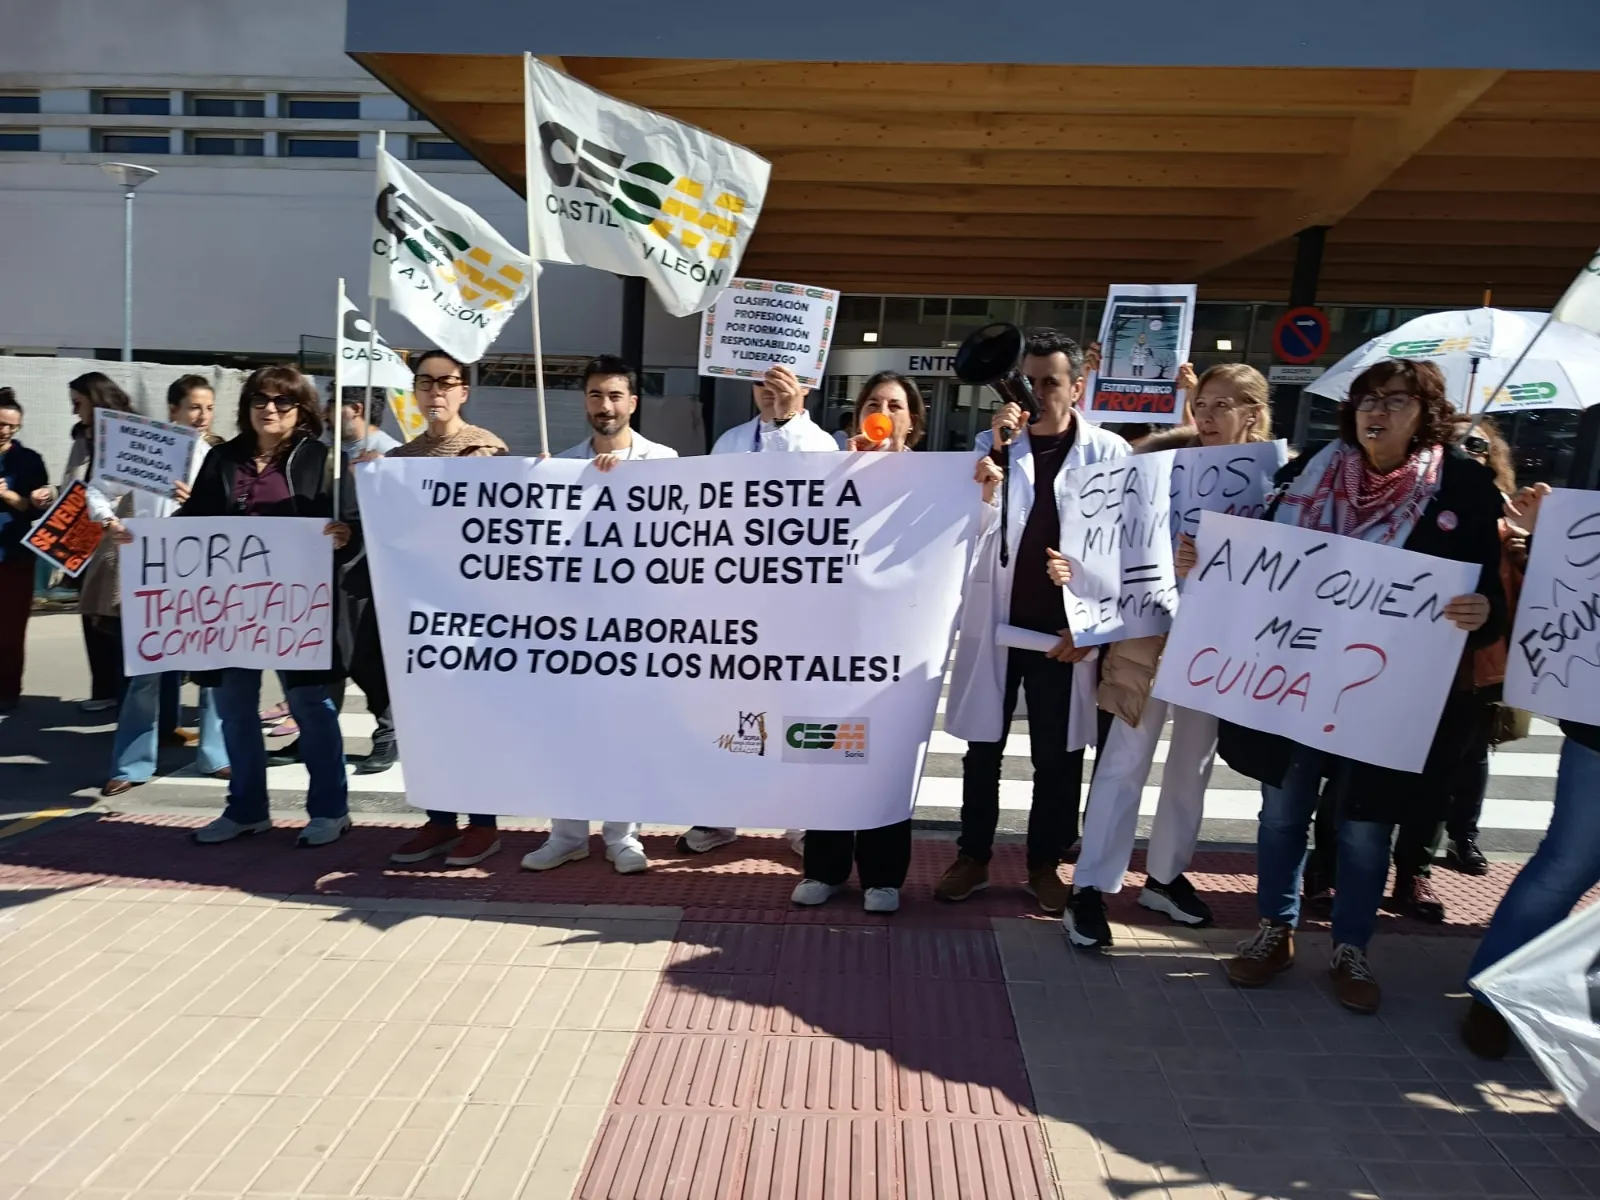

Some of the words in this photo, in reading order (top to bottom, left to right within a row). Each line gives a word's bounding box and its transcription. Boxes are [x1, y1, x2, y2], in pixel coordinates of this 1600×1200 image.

[545, 194, 622, 229] CASTIL
[660, 249, 725, 287] LEÓN
[733, 295, 809, 311] CLASIFICACIÓN
[734, 309, 804, 324] PROFESIONAL
[725, 322, 745, 332] POR
[748, 326, 810, 339] FORMACIÓN
[342, 347, 398, 362] CAST
[720, 335, 811, 354] RESPONSABILIDAD
[732, 350, 739, 358] Y
[740, 350, 797, 365] LIDERAZGO
[909, 355, 958, 371] ENTR
[1093, 391, 1175, 412] PROPIO
[120, 425, 176, 446] MEJORAS
[130, 440, 146, 451] EN
[148, 445, 163, 456] LA
[116, 451, 173, 472] JORNADA
[116, 464, 170, 485] LABORAL
[422, 479, 468, 507] "DE
[478, 481, 584, 511] NORTE
[592, 485, 617, 511] A
[626, 483, 689, 515] SUR,
[698, 481, 734, 510] DE
[744, 479, 826, 507] ESTE
[835, 479, 862, 507] A
[1080, 457, 1256, 518] SERVCIOS
[30, 528, 59, 551] SE
[461, 517, 572, 546] OESTE.
[583, 521, 624, 547] LA
[633, 519, 735, 547] LUCHA
[743, 517, 859, 551] SIGUE,
[141, 533, 272, 586] HORA
[459, 553, 584, 583] CUESTE
[593, 557, 635, 584] LO
[646, 557, 705, 584] QUE
[715, 553, 860, 584] CUESTE"
[1197, 538, 1232, 582] A
[1241, 543, 1329, 592] MÍ
[1315, 570, 1446, 623] QUIÉN
[133, 581, 331, 628] TRABAJADA
[408, 610, 578, 642] DERECHOS
[585, 617, 759, 645] LABORALES
[1254, 616, 1323, 650] ME
[137, 622, 325, 661] COMPUTADA
[406, 644, 519, 674] ¡COMO
[527, 648, 638, 677] TODOS
[645, 652, 702, 678] LOS
[709, 654, 901, 682] MORTALES!
[785, 722, 866, 750] CESM
